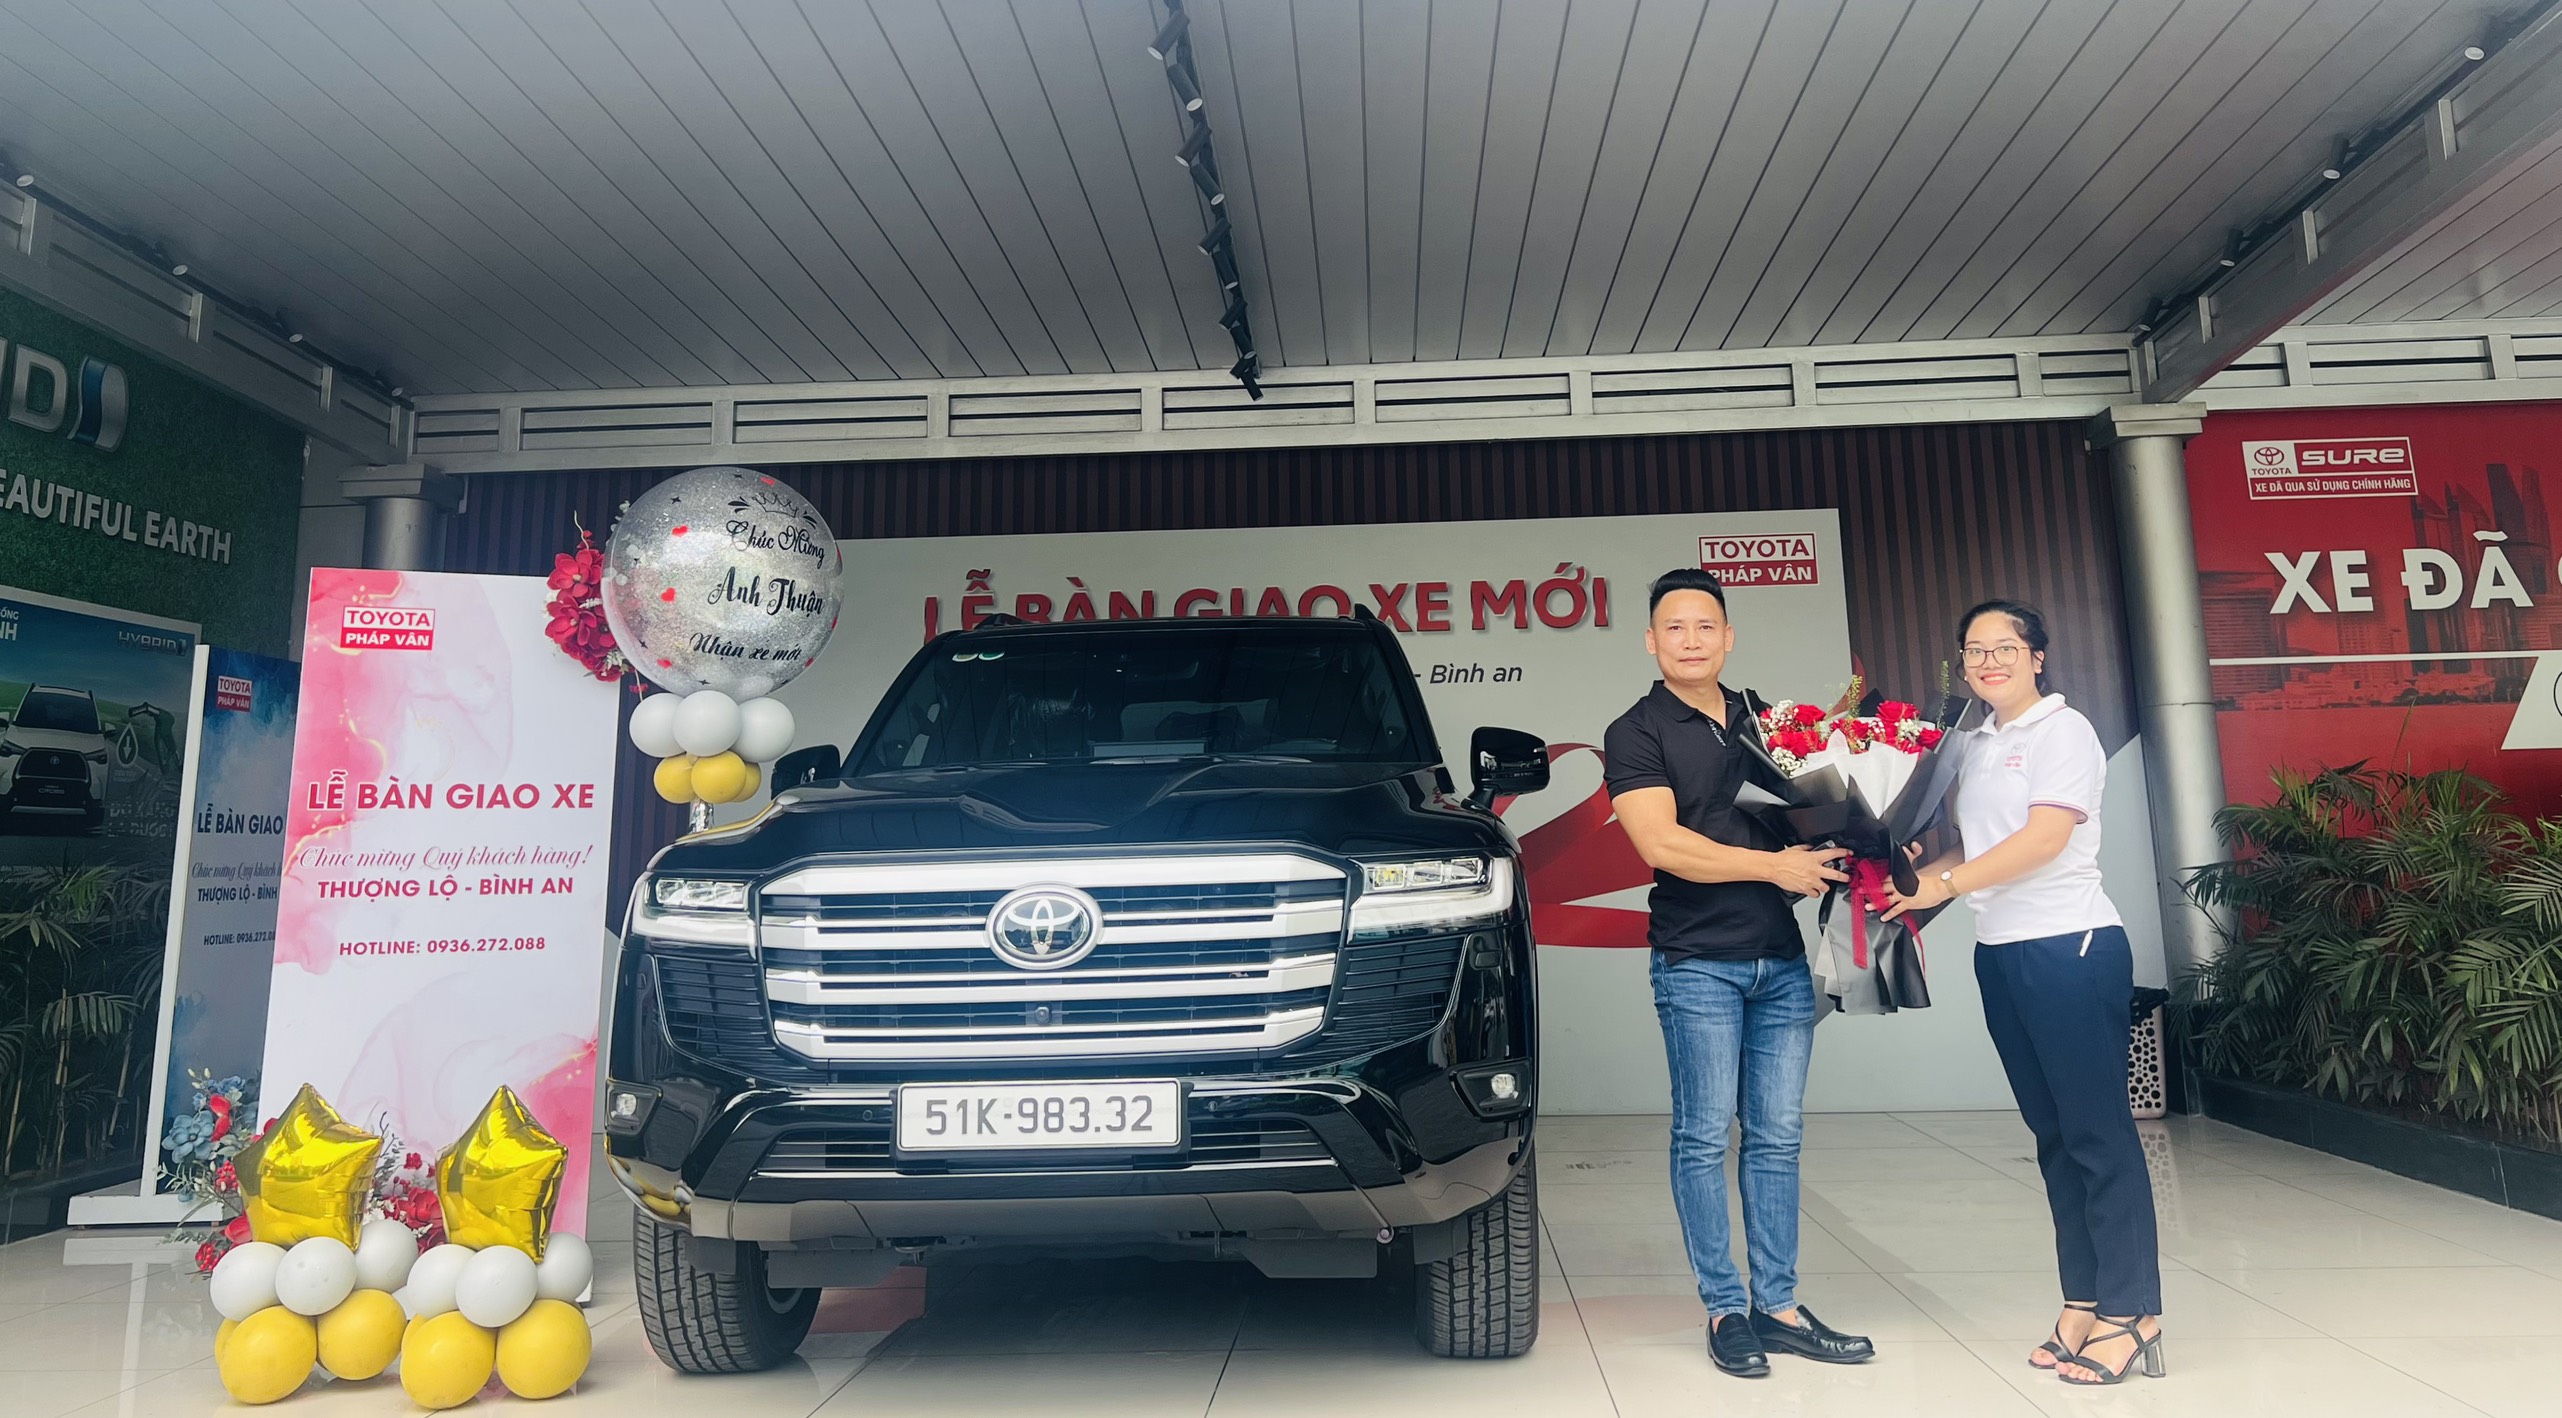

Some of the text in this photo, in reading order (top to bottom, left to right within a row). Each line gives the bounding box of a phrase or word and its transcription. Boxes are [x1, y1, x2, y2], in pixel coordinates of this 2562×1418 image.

[2252, 467, 2292, 476] TOYOTA
[2255, 482, 2268, 493] XE
[2270, 481, 2283, 492] ĐÃ
[2286, 481, 2305, 492] QUA
[2322, 480, 2350, 493] DỤNG
[2352, 477, 2382, 490] CHÍNH
[2384, 477, 2412, 490] HÃNG
[145, 511, 232, 564] EARTH
[726, 520, 774, 551] Chúc
[1705, 539, 1810, 559] TOYOTA
[1708, 563, 1812, 583] PHÁP VÂN
[2264, 550, 2374, 614] XE
[2400, 530, 2534, 610] ĐÃ
[707, 566, 824, 617] Anh Thuận
[1015, 576, 1154, 623] BÀN
[1174, 585, 1352, 618] GIAO
[1368, 582, 1451, 632] XE
[1471, 562, 1609, 629] MỚI
[347, 610, 430, 627] TOYOTA
[345, 631, 430, 646] PHÁP VÂN
[690, 632, 745, 660] Nhận
[772, 643, 802, 661] mới
[1430, 663, 1484, 684] Bình
[1493, 666, 1523, 683] an
[219, 678, 251, 693] TOYOTA
[217, 695, 235, 706] PHÁP
[308, 770, 595, 810] LỄ BÀN GIAO XE
[197, 803, 213, 833] LỄ
[216, 808, 245, 834] BÀN
[249, 814, 283, 835] GIAO
[299, 845, 593, 872] Chúc mừng Quý khách hàng!
[192, 862, 213, 879] Chúc
[198, 886, 236, 906] THƯỢNG
[239, 884, 251, 904] LỘ
[257, 883, 278, 900] BÌNH
[318, 878, 420, 903] THƯỢNG
[429, 874, 458, 902] LỘ
[479, 874, 534, 895] BÌNH
[541, 877, 574, 894] AN
[204, 933, 235, 946] HOTLINE:
[339, 937, 546, 956] HOTLINE: 0936.272.088
[926, 1095, 1153, 1136] 51K-983.32
